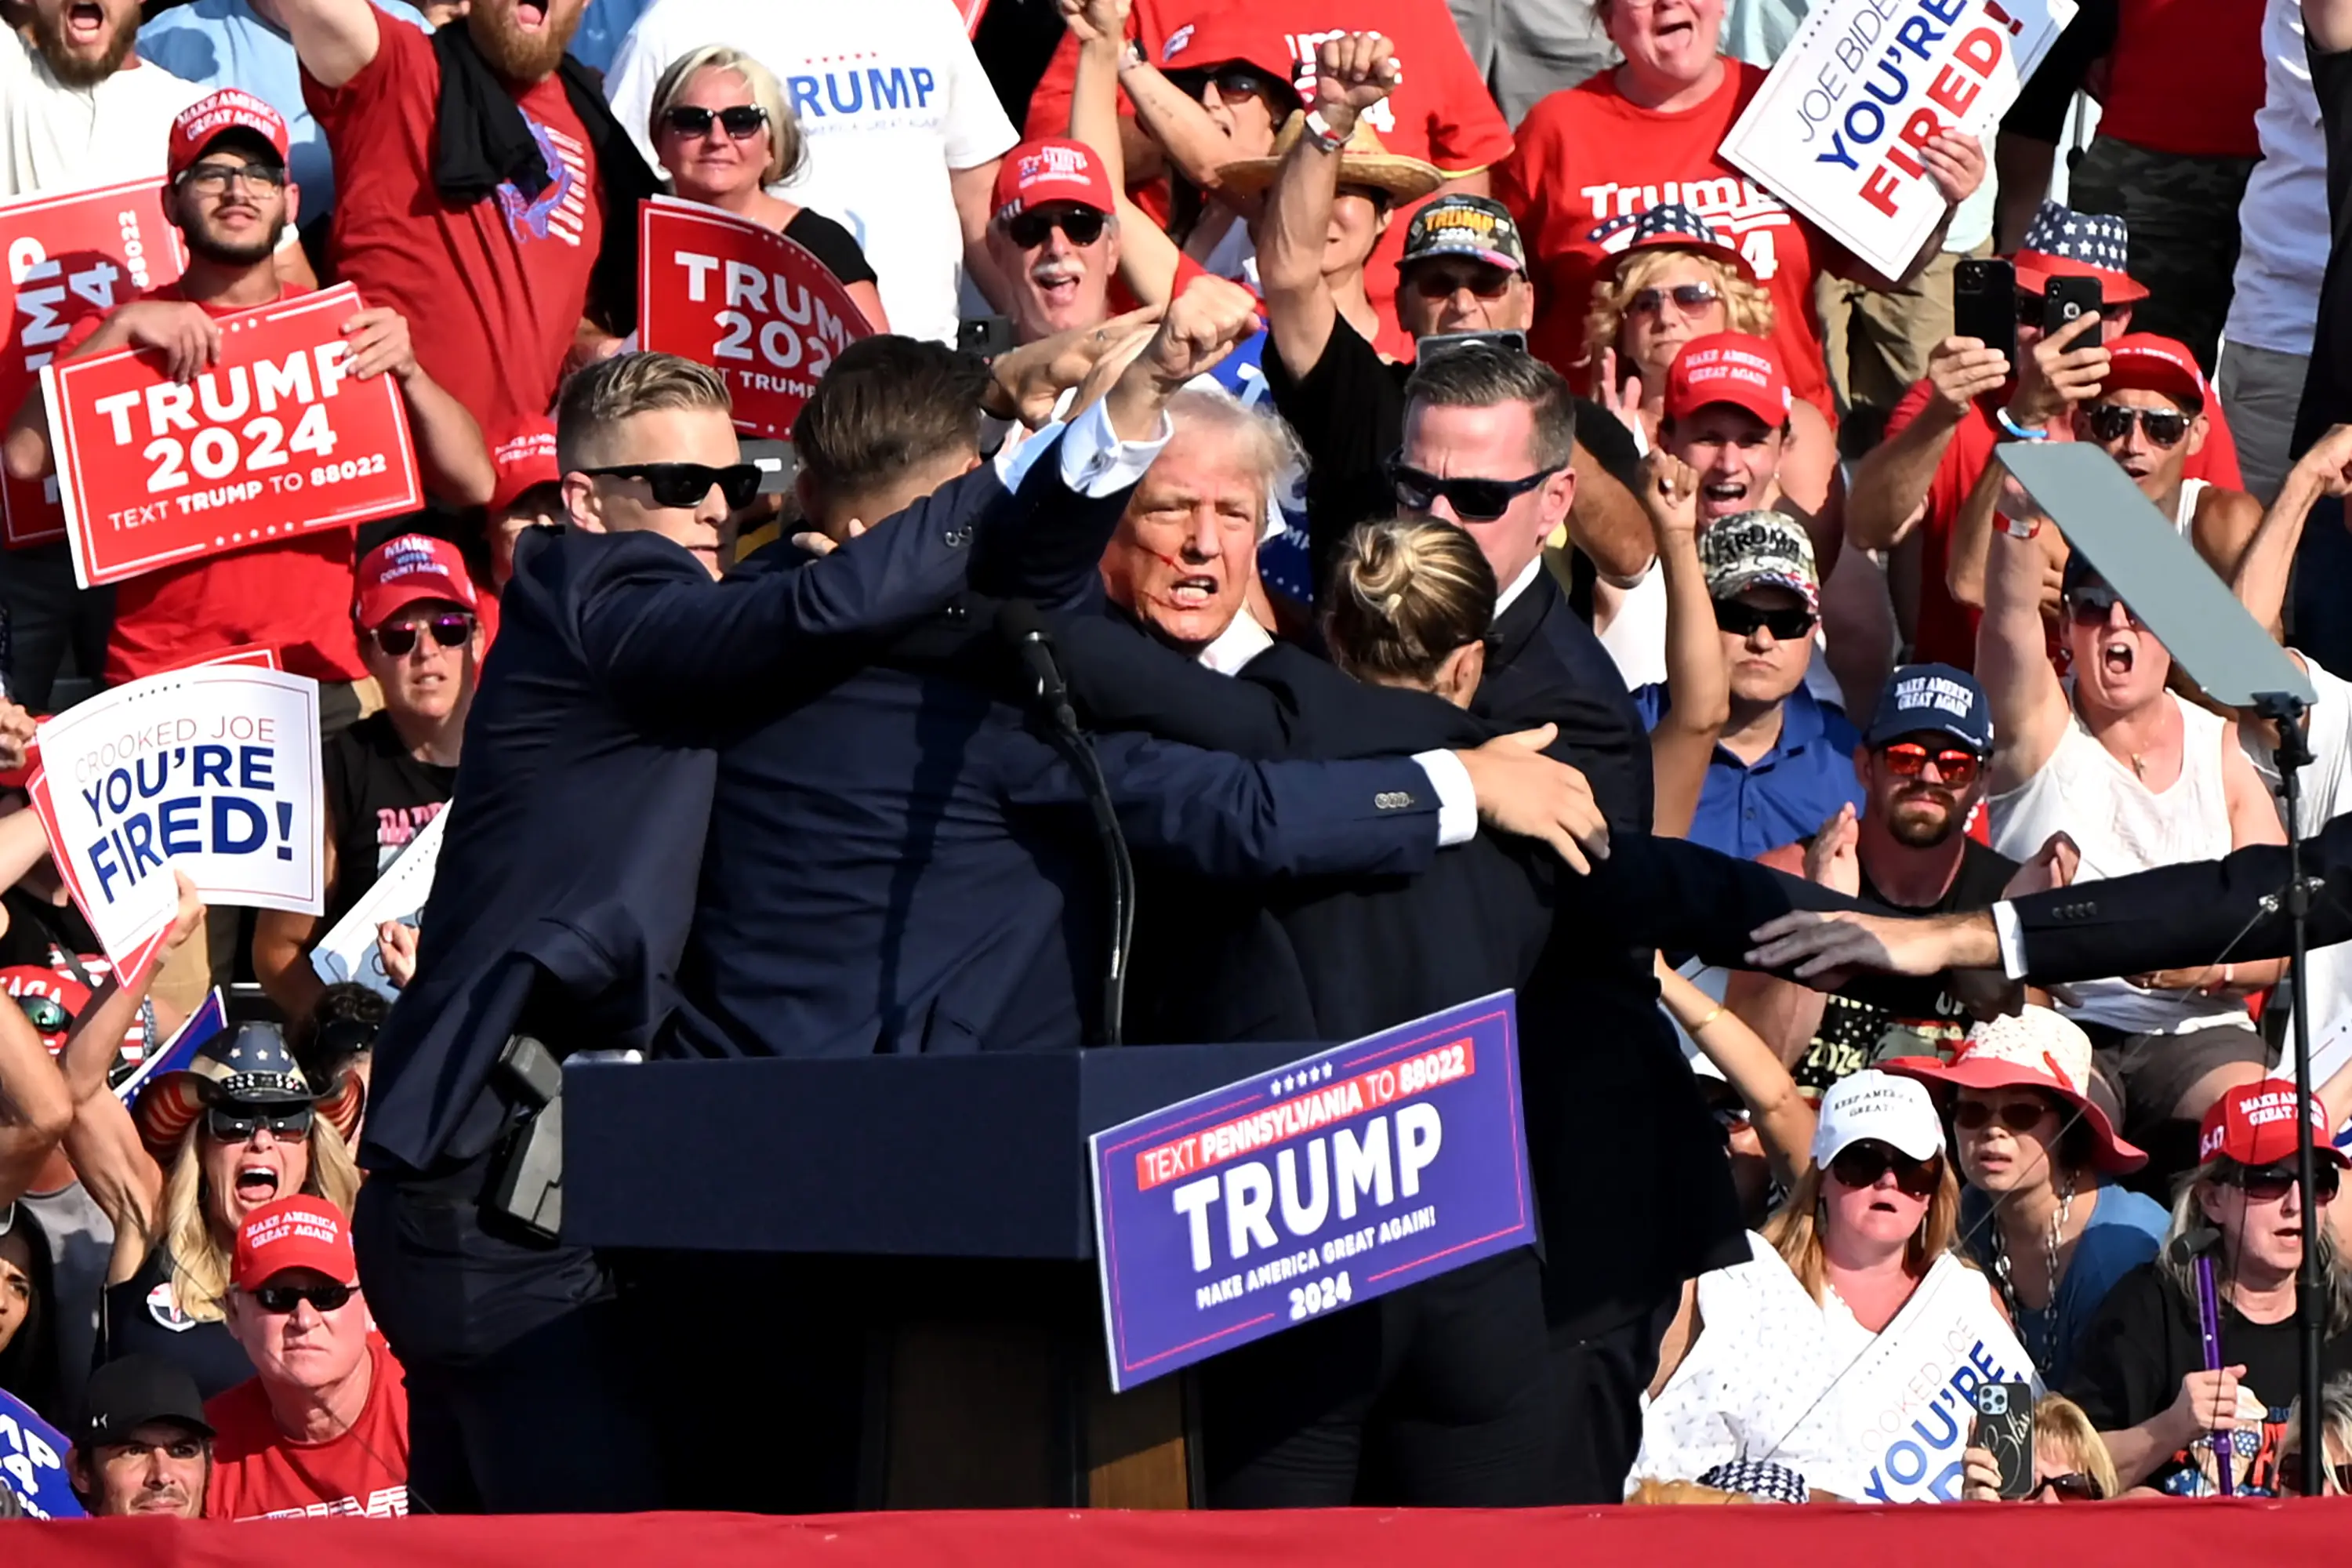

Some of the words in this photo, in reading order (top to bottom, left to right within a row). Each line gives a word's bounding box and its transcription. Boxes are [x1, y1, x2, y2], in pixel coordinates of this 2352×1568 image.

[786, 67, 935, 118] RUMP
[1796, 62, 1847, 143] JOE
[1835, 0, 1900, 74] BIDE
[1814, 0, 1968, 172] YOU'RE
[176, 95, 218, 129] MAKE
[218, 90, 281, 126] AMERICA
[187, 108, 233, 141] GREAT
[233, 111, 275, 140] AGAIN
[1858, 0, 2024, 219] FIRED!
[1425, 209, 1494, 232] TRUMP
[713, 310, 832, 378] 202
[1685, 349, 1719, 369] MAKE
[1722, 349, 1773, 376] AMERICA
[95, 340, 359, 446] TRUMP
[1688, 366, 1729, 384] GREAT
[1730, 367, 1767, 388] AGAIN
[143, 403, 338, 494] 2024
[108, 500, 171, 532] TEXT
[176, 481, 263, 514] TRUMP
[269, 472, 303, 494] TO
[310, 454, 387, 487] 88022
[380, 564, 414, 584] COUNT
[416, 561, 450, 576] AGAIN
[385, 536, 435, 560] MAKE
[1895, 677, 1927, 698] MAKE
[1926, 677, 1974, 709] AMERICA
[1898, 691, 1934, 711] GREAT
[1934, 693, 1968, 719] AGAIN
[75, 719, 197, 784] CROOKED
[211, 716, 275, 742] JOE
[82, 744, 274, 828] YOU'RE
[87, 795, 292, 905] FIRED!
[0, 976, 62, 1004] AGA
[1145, 1138, 1197, 1183] TEXT
[1200, 1082, 1363, 1163] PENNSYLVANIA
[1367, 1070, 1396, 1102] TO
[1399, 1044, 1466, 1094] 88022
[1834, 1094, 1860, 1111] KEEP
[1864, 1089, 1914, 1104] AMERA
[2239, 1092, 2279, 1114] MAKE
[2249, 1105, 2293, 1127] GREAT
[1172, 1102, 1443, 1273] TRUMP
[245, 1214, 280, 1238] MAKE
[281, 1210, 339, 1234] AMERICA
[251, 1224, 291, 1249] GREAT
[293, 1224, 335, 1244] AGAIN
[1196, 1274, 1243, 1311] MAKE
[1245, 1247, 1320, 1293] AMERICA
[1321, 1229, 1375, 1265] GREAT
[1377, 1204, 1437, 1245] AGAIN!
[1288, 1271, 1352, 1321] 2024
[1860, 1362, 1943, 1453] OOKED
[1863, 1339, 2005, 1504] YOU'RE
